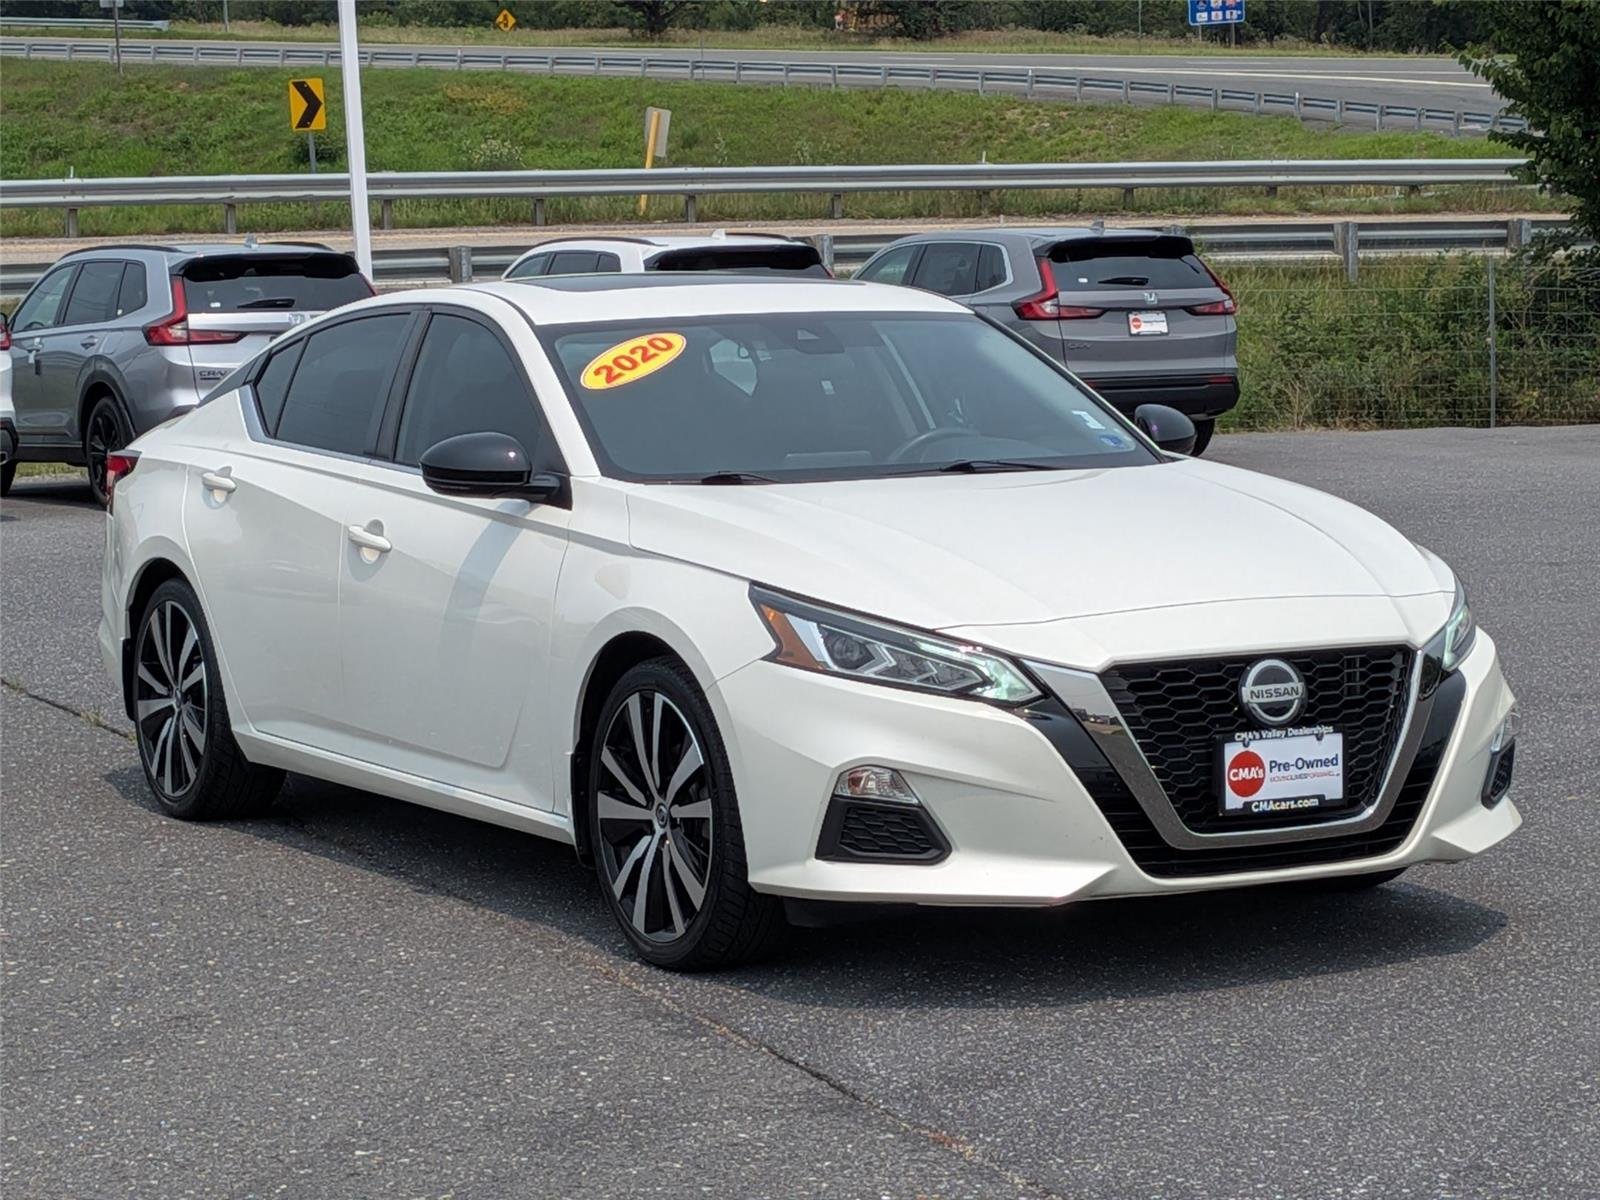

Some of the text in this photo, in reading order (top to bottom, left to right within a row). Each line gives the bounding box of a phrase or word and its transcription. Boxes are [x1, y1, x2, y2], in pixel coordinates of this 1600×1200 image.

[593, 336, 674, 384] 2020
[1250, 686, 1299, 700] NISSAN
[1260, 729, 1286, 739] Valley
[1269, 753, 1338, 773] Pre-Owned
[1229, 766, 1264, 781] CMA's
[1251, 798, 1319, 812] CMAcars.com
